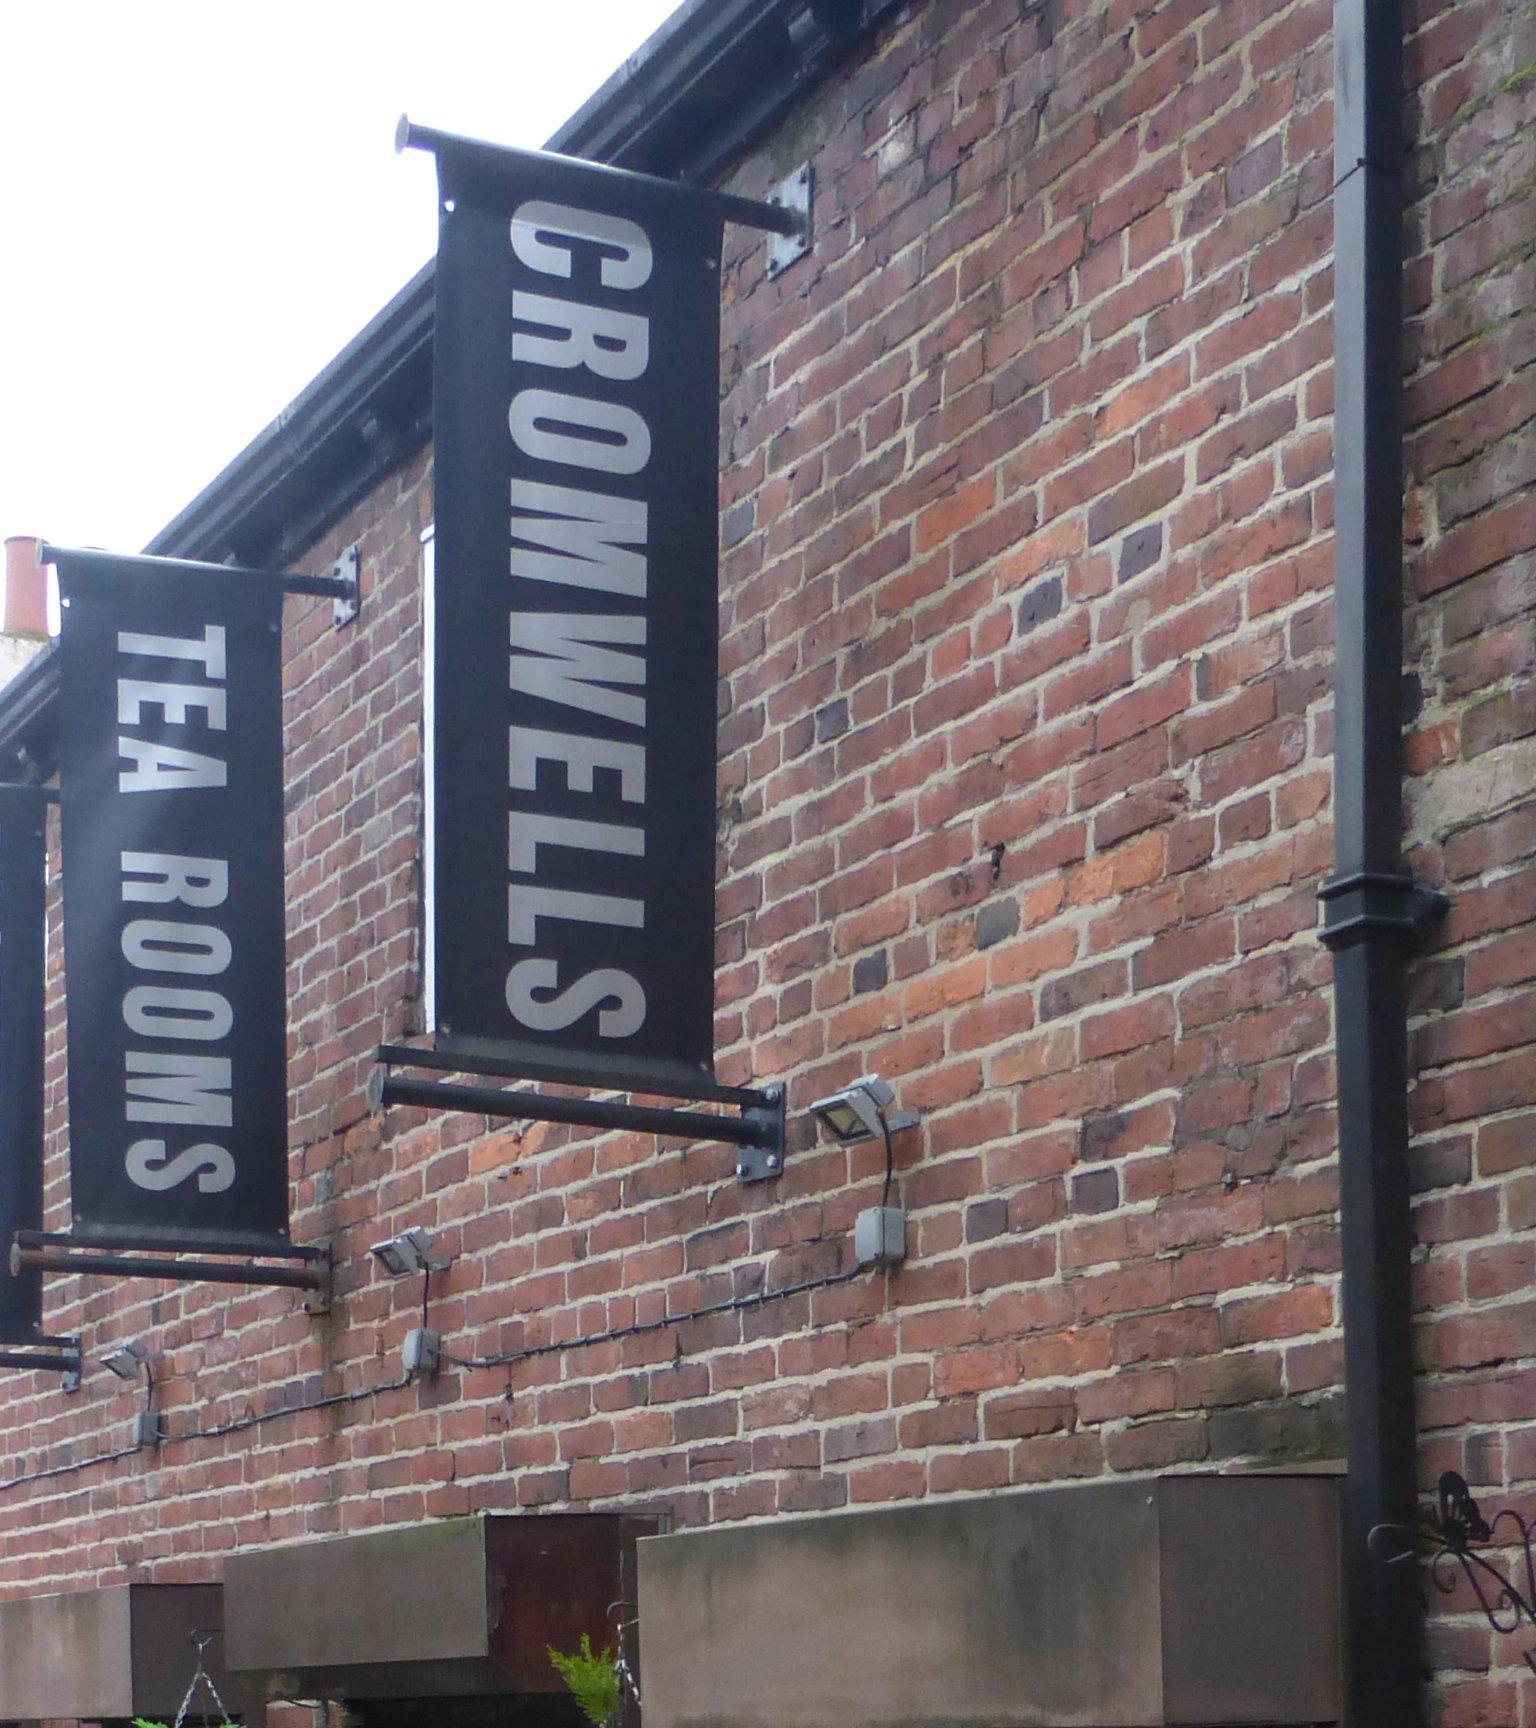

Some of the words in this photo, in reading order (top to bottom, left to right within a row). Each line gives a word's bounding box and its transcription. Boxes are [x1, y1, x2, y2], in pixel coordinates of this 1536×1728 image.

[115, 623, 228, 795] TEA
[505, 198, 654, 1040] CROMWELLS
[119, 850, 236, 1196] ROOMS
